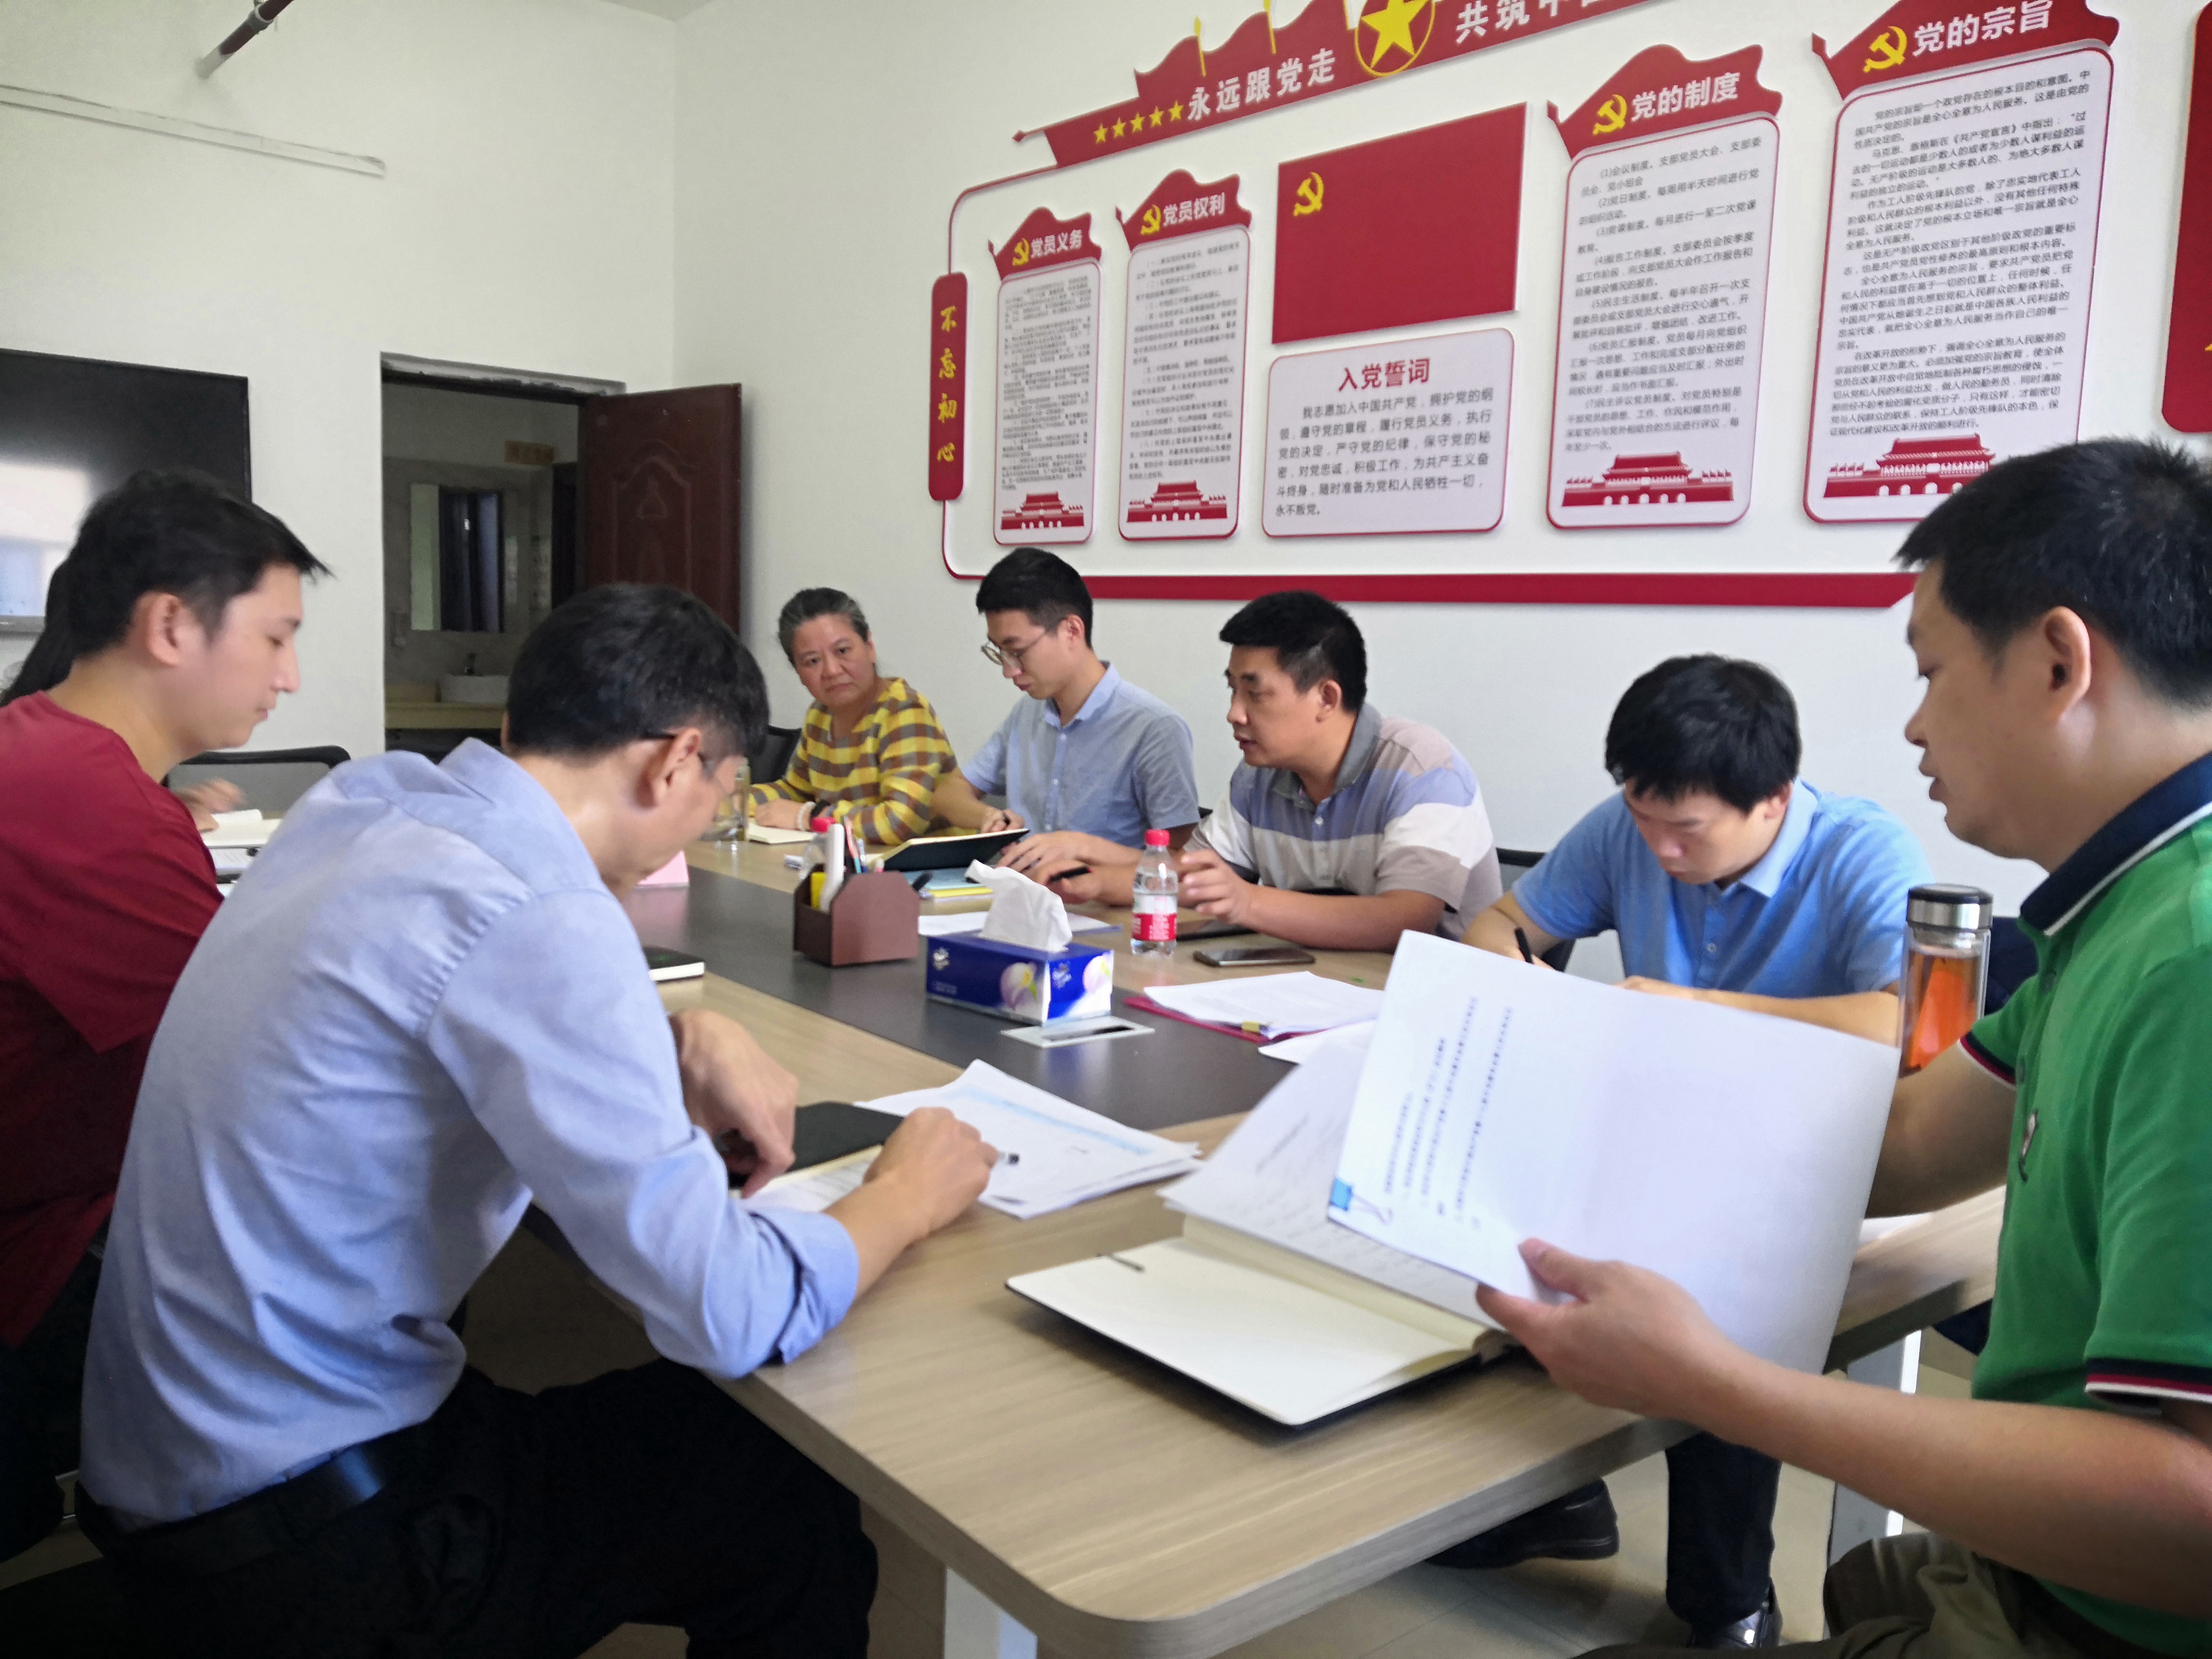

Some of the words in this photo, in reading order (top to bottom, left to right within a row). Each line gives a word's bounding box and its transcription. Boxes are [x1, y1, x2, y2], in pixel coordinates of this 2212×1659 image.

[1912, 0, 2054, 57] 党的宗旨
[1187, 48, 1335, 121] 永远跟党走
[1631, 72, 1741, 122] 党的制度
[1163, 192, 1225, 227] 党员权利
[1031, 229, 1083, 259] 党员义务
[936, 305, 958, 462] 不忘初心
[1337, 357, 1430, 393] 入党誓词
